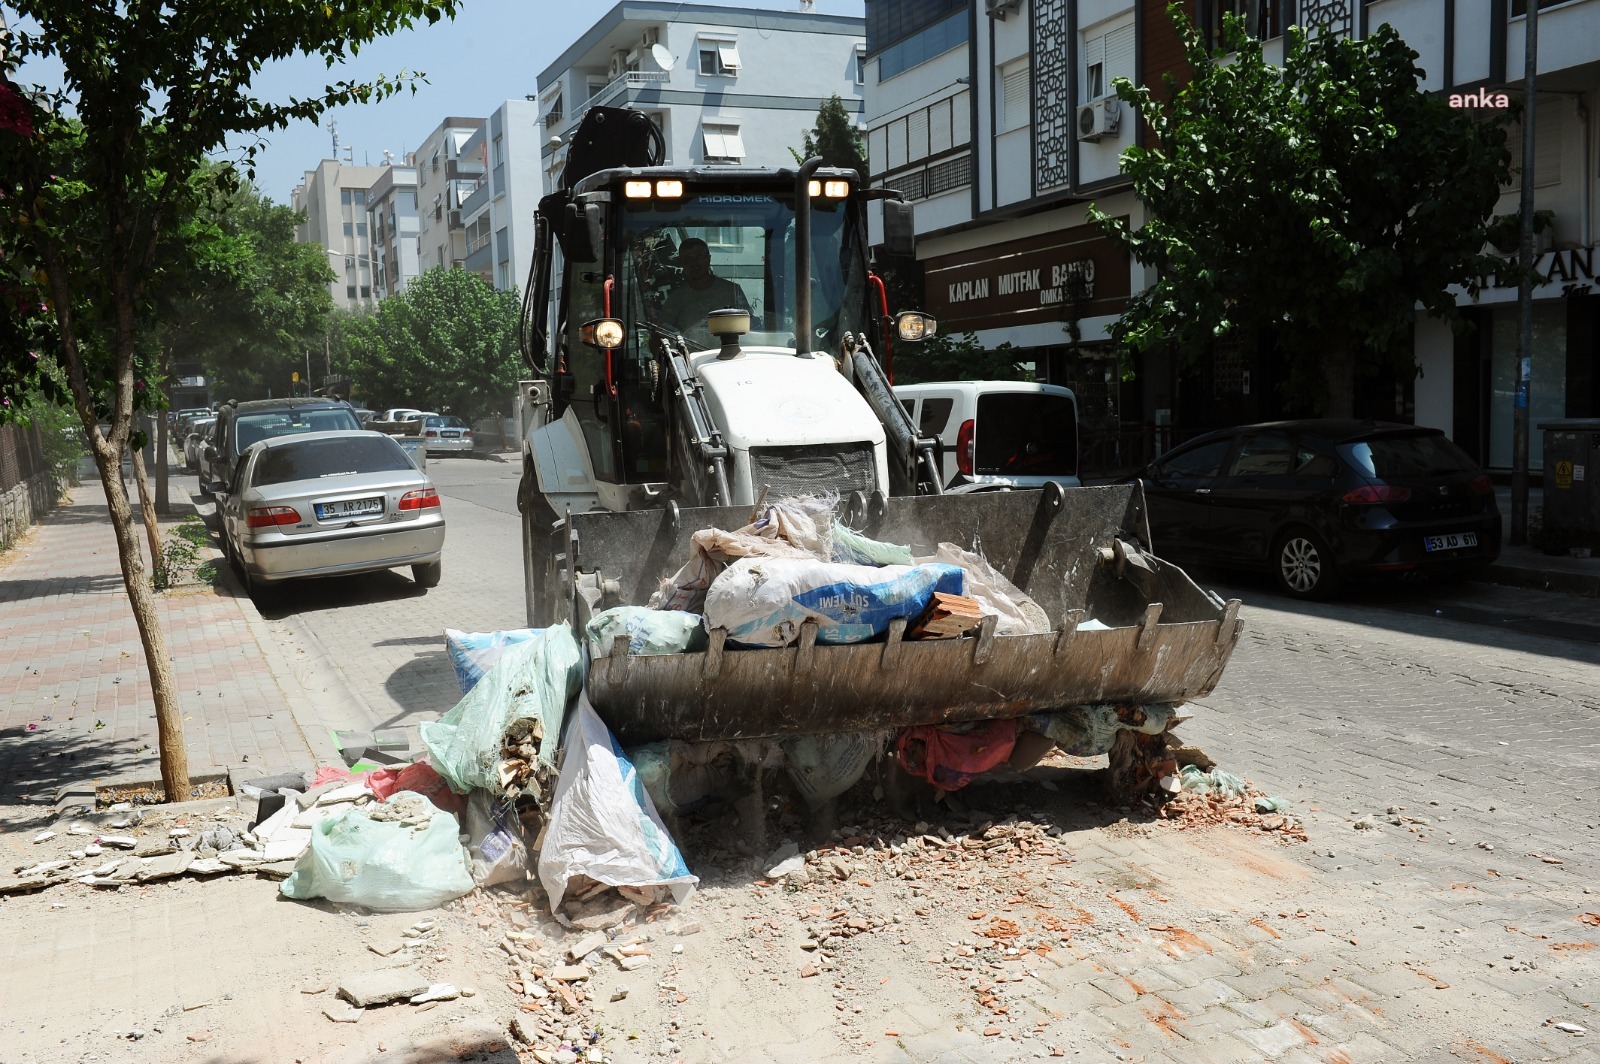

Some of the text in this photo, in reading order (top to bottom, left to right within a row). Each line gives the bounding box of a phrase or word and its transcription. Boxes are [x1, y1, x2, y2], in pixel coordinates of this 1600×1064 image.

[949, 277, 989, 303] KAPLAN
[998, 268, 1040, 296] MUTFAK
[323, 503, 336, 515] 35
[343, 501, 354, 513] AR
[356, 499, 379, 511] 2175
[1430, 533, 1477, 550] 53 AD 611
